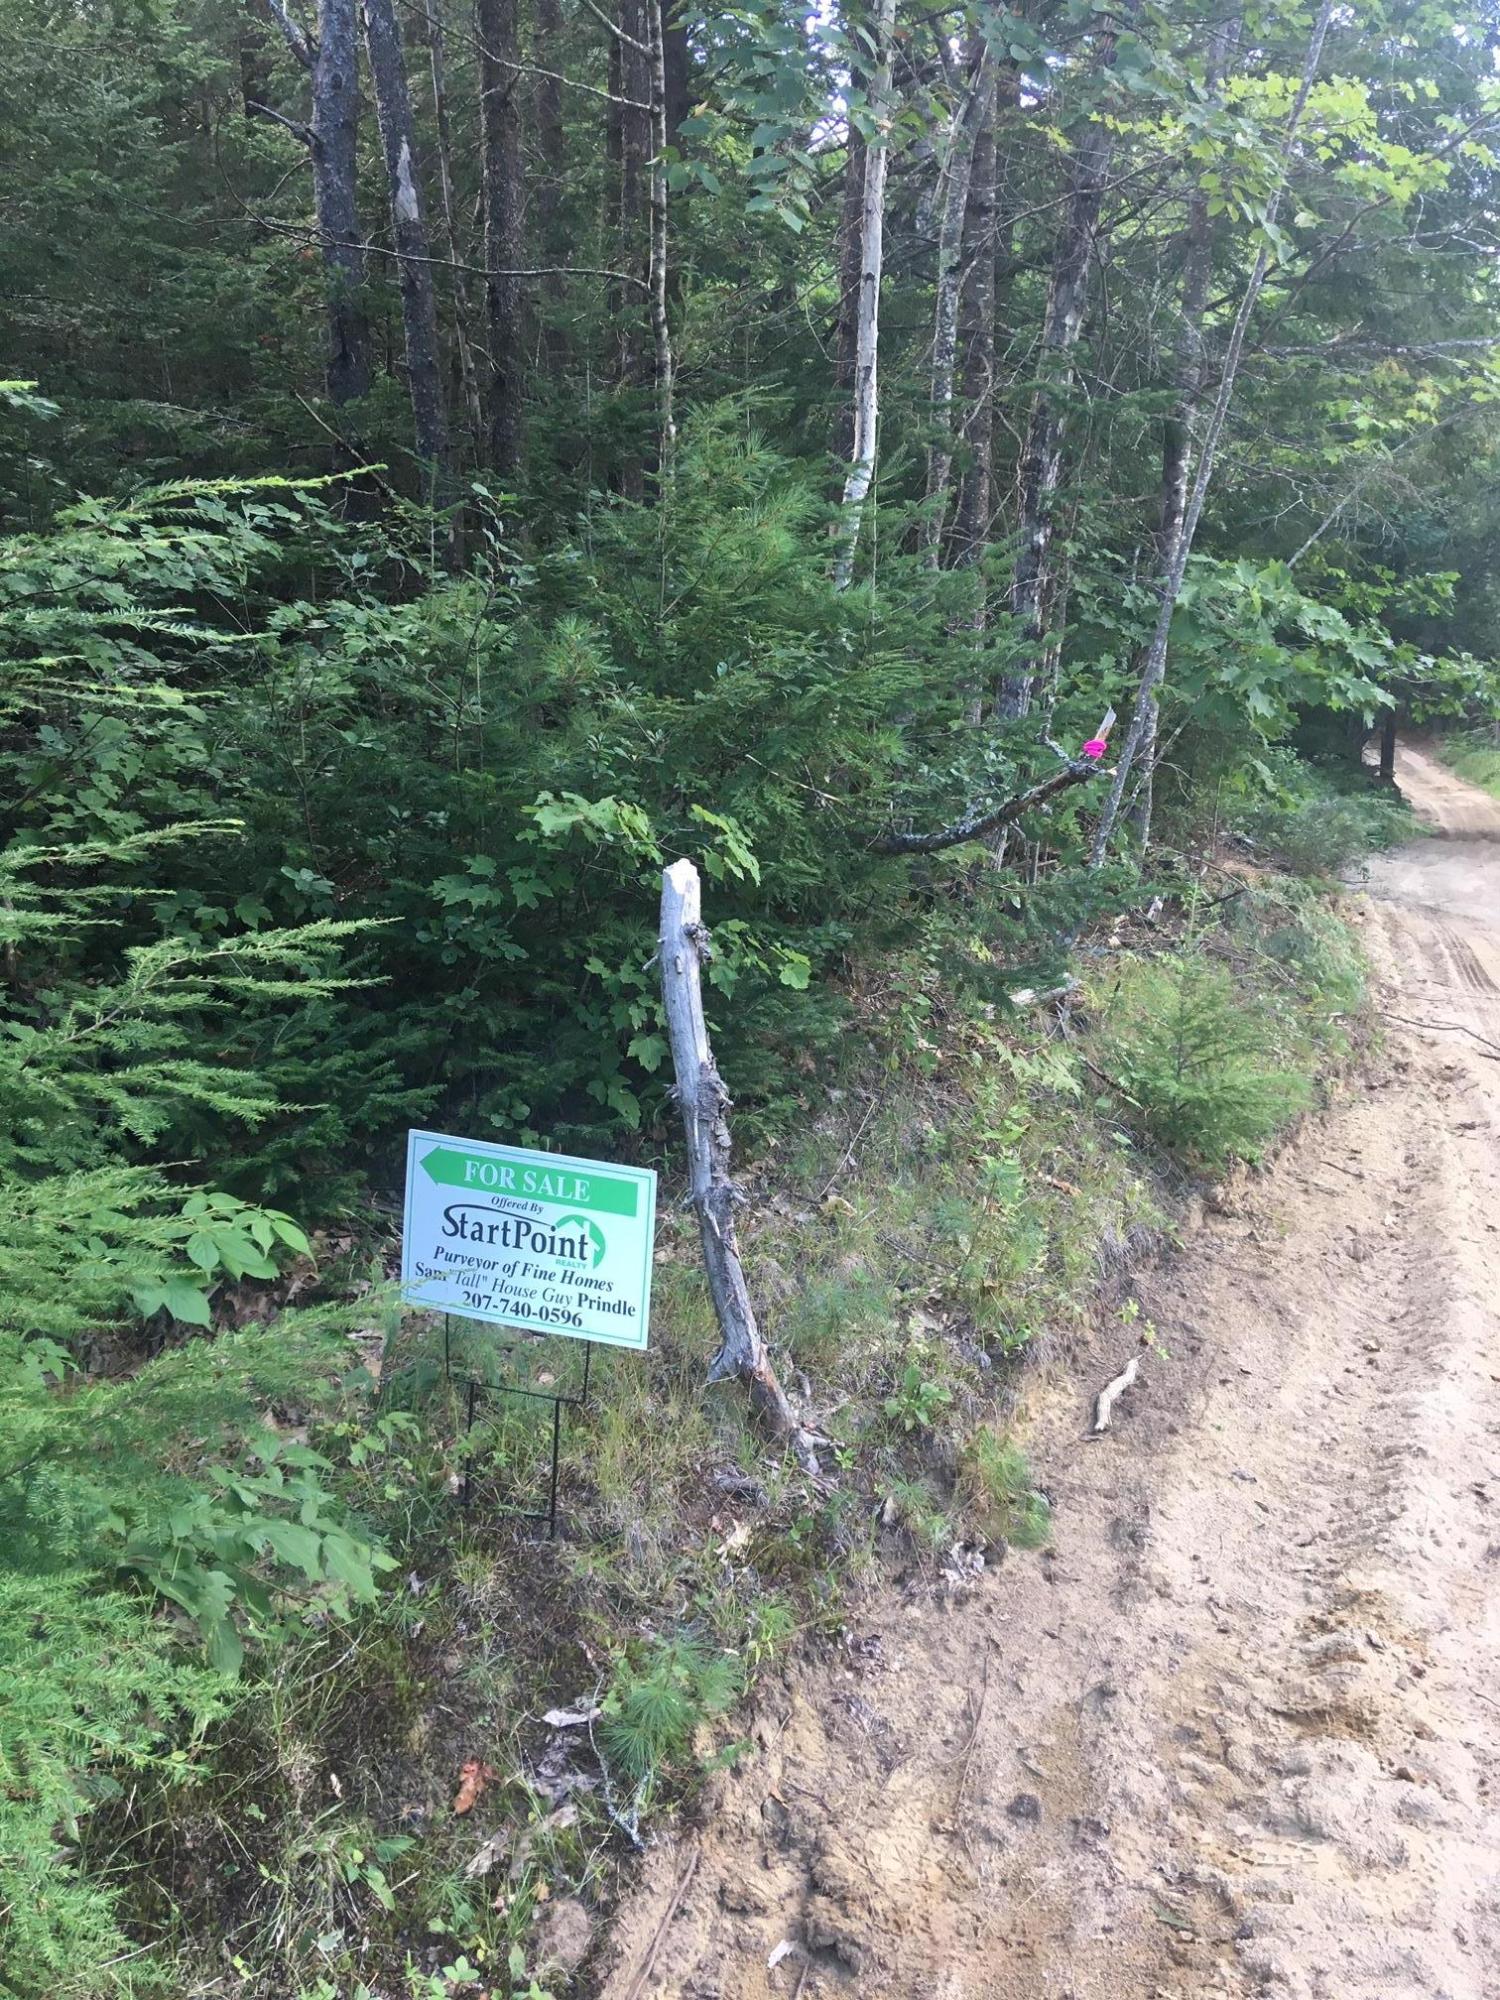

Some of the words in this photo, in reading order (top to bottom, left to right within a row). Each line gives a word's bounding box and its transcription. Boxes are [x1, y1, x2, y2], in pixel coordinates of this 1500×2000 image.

[464, 1160, 515, 1191] FOR
[523, 1171, 591, 1202] SALE
[491, 1196, 527, 1211] Offered
[529, 1201, 544, 1214] By
[442, 1204, 588, 1261] StartPoint
[434, 1246, 499, 1271] Purveyor
[502, 1260, 518, 1277] of
[521, 1263, 556, 1282] Fine
[560, 1270, 614, 1292] Homes
[555, 1259, 588, 1269] REALTY
[462, 1291, 583, 1327] 207-740-0596
[492, 1278, 537, 1299] House
[542, 1287, 573, 1308] Guy
[578, 1293, 636, 1317] Prindle
